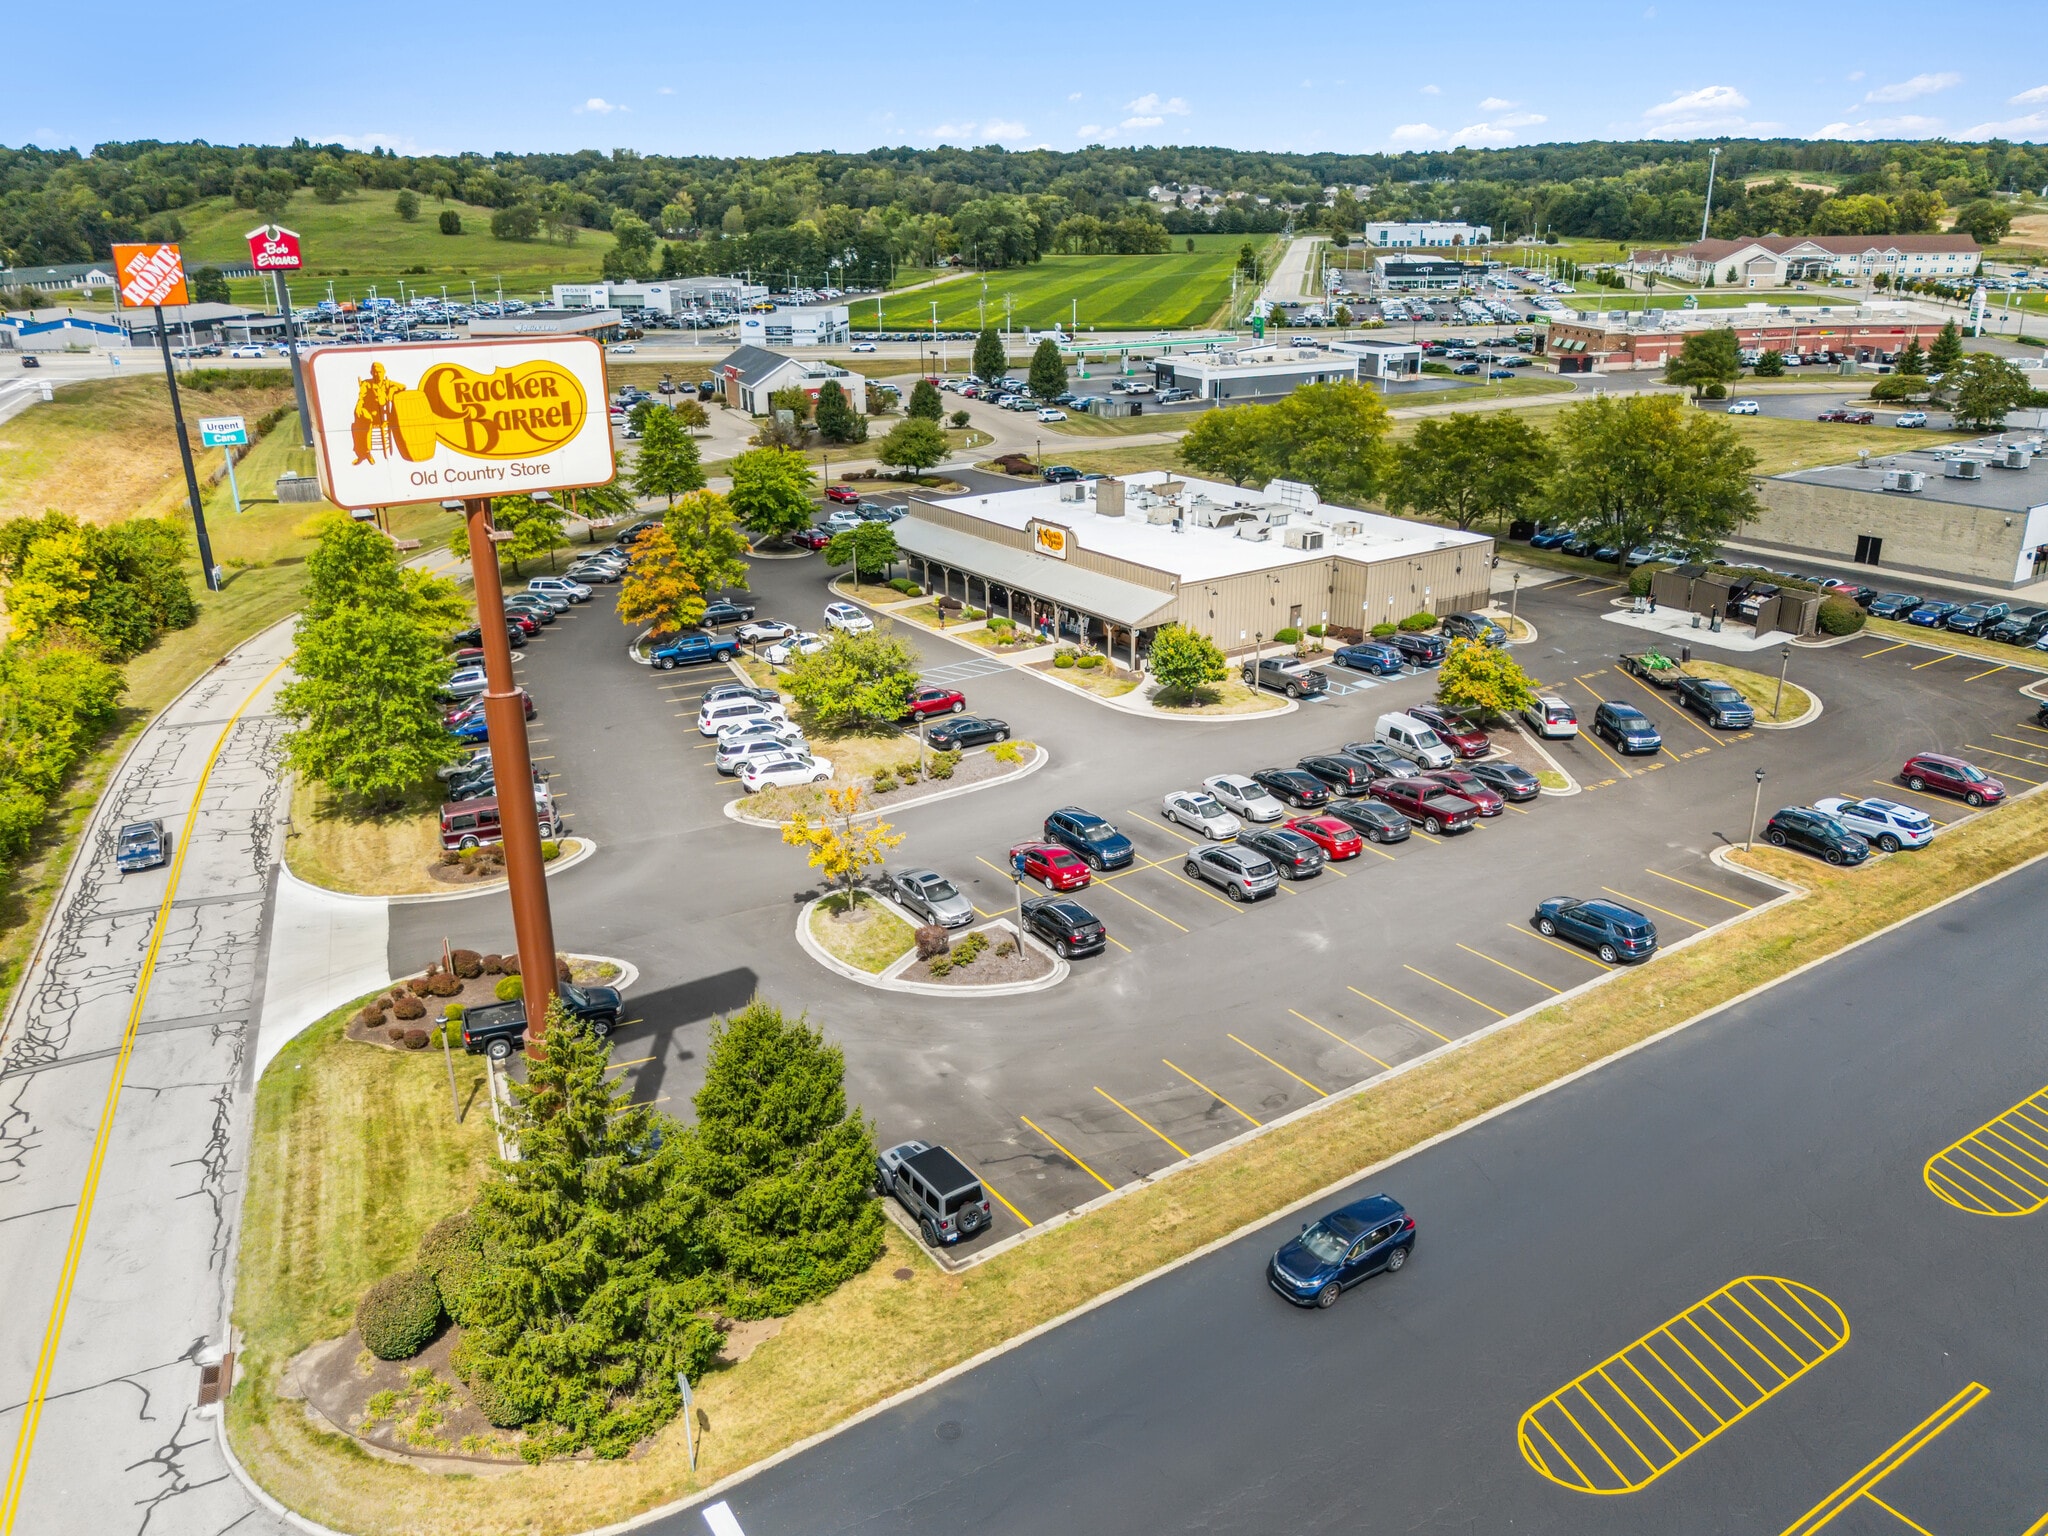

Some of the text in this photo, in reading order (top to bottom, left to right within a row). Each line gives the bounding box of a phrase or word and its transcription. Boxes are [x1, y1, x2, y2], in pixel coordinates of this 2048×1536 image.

[257, 252, 300, 267] Evans
[263, 242, 289, 255] Bob
[122, 244, 181, 306] HOME
[124, 251, 150, 277] THE
[148, 265, 184, 305] DEPOT
[424, 367, 559, 419] Cracker
[206, 422, 239, 432] Urgent
[213, 434, 237, 443] Care
[461, 400, 573, 454] Barrel
[410, 462, 551, 486] Old Country Store
